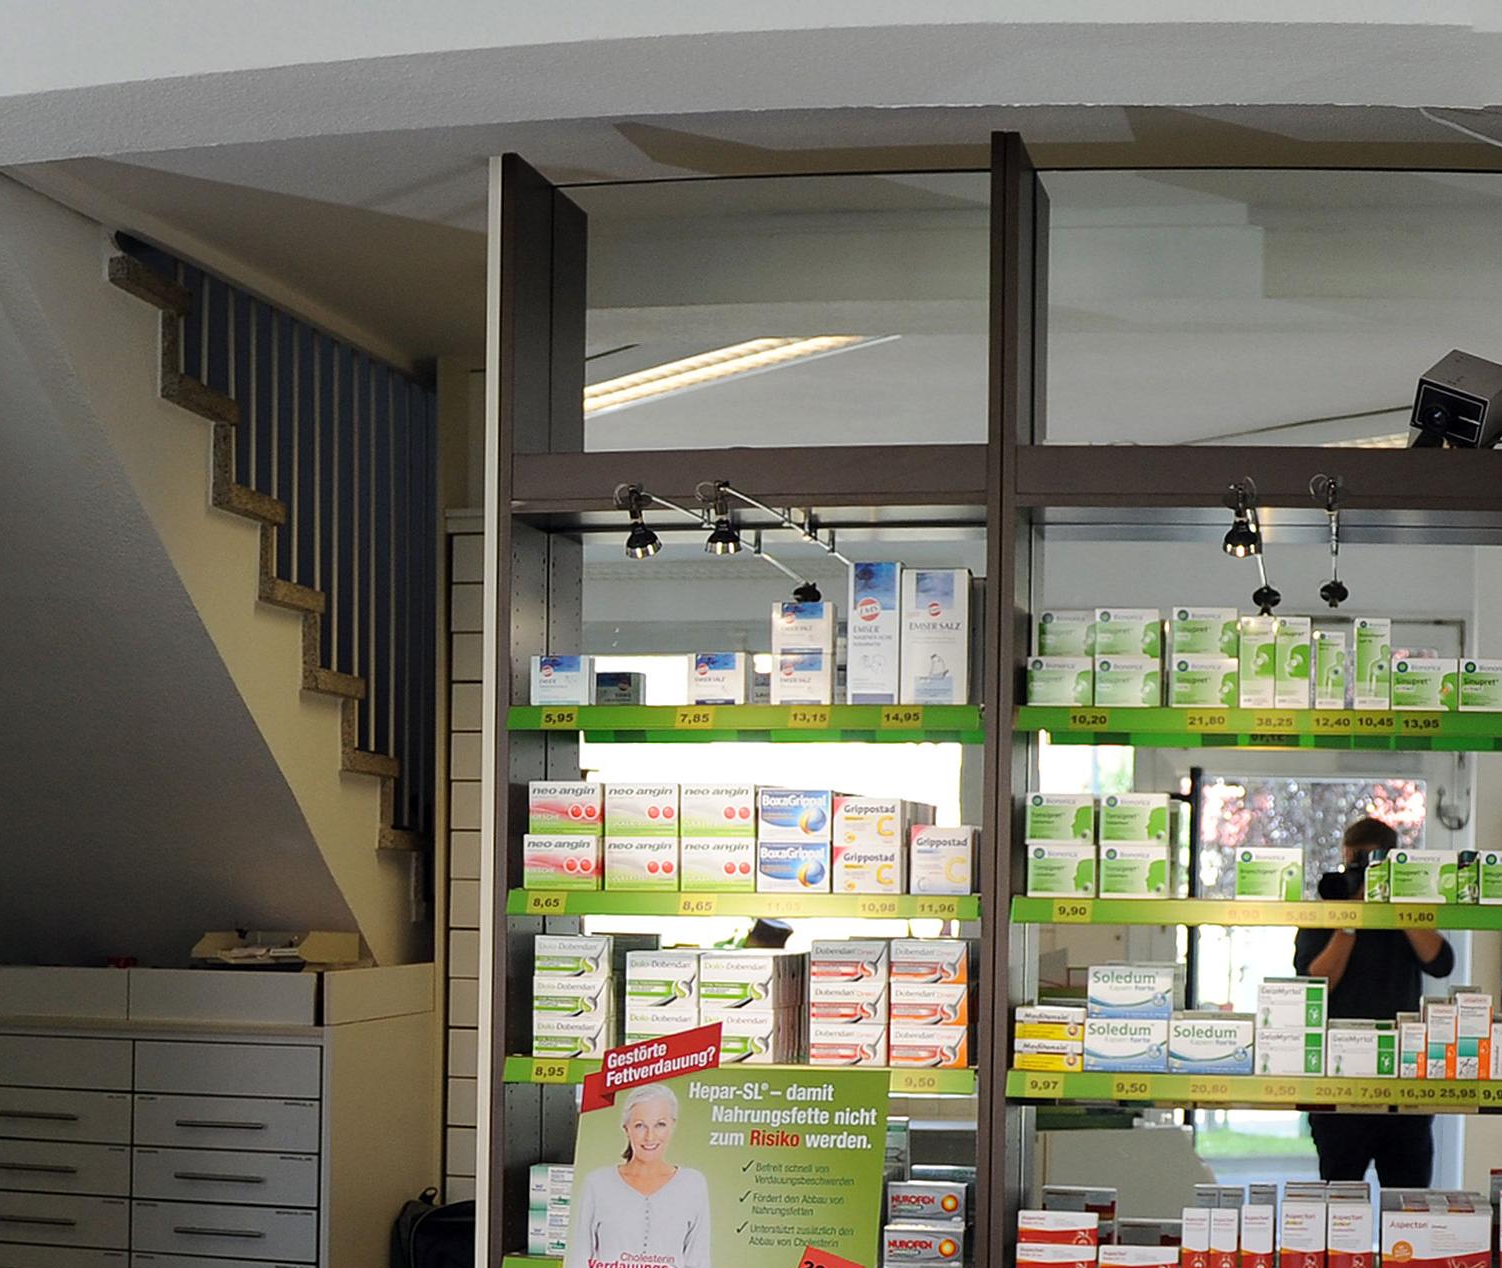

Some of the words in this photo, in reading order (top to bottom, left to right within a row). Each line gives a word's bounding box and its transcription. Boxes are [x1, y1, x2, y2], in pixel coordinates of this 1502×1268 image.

[543, 711, 575, 726] 5,95
[679, 712, 710, 726] 7,85
[791, 711, 828, 725] 13,15
[883, 710, 921, 724] 14,95
[1071, 714, 1108, 726] 10,20
[1256, 716, 1294, 728] 38,25
[1314, 716, 1350, 728] 12,40
[1357, 716, 1394, 728] 10,45
[1403, 717, 1439, 730] 13,95
[532, 786, 557, 795] neo
[559, 785, 595, 797] angin
[843, 804, 896, 816] Grippostad
[916, 837, 968, 849] Grippostad
[843, 853, 895, 865] Grippostad
[532, 897, 560, 909] 8,65
[1058, 905, 1086, 917] 9,90
[1092, 971, 1157, 985] Soledum
[1088, 1023, 1153, 1037] Soledum
[1174, 1025, 1239, 1039] Soledum
[607, 1044, 667, 1068] Gestörte
[535, 1065, 565, 1078] 8,95
[606, 1046, 716, 1088] Fettverdauung?
[1030, 1079, 1060, 1091] 9,97
[1116, 1082, 1147, 1094] 9,50
[786, 1084, 834, 1101] damit
[1399, 1087, 1435, 1099] 16,30
[1440, 1087, 1477, 1100] 25,95
[712, 1105, 829, 1127] Nahrungsfette
[834, 1107, 877, 1126] nicht
[710, 1131, 744, 1146] zum
[750, 1129, 800, 1147] Risiko
[805, 1131, 872, 1149] werden.
[620, 1252, 675, 1263] Cholesterin
